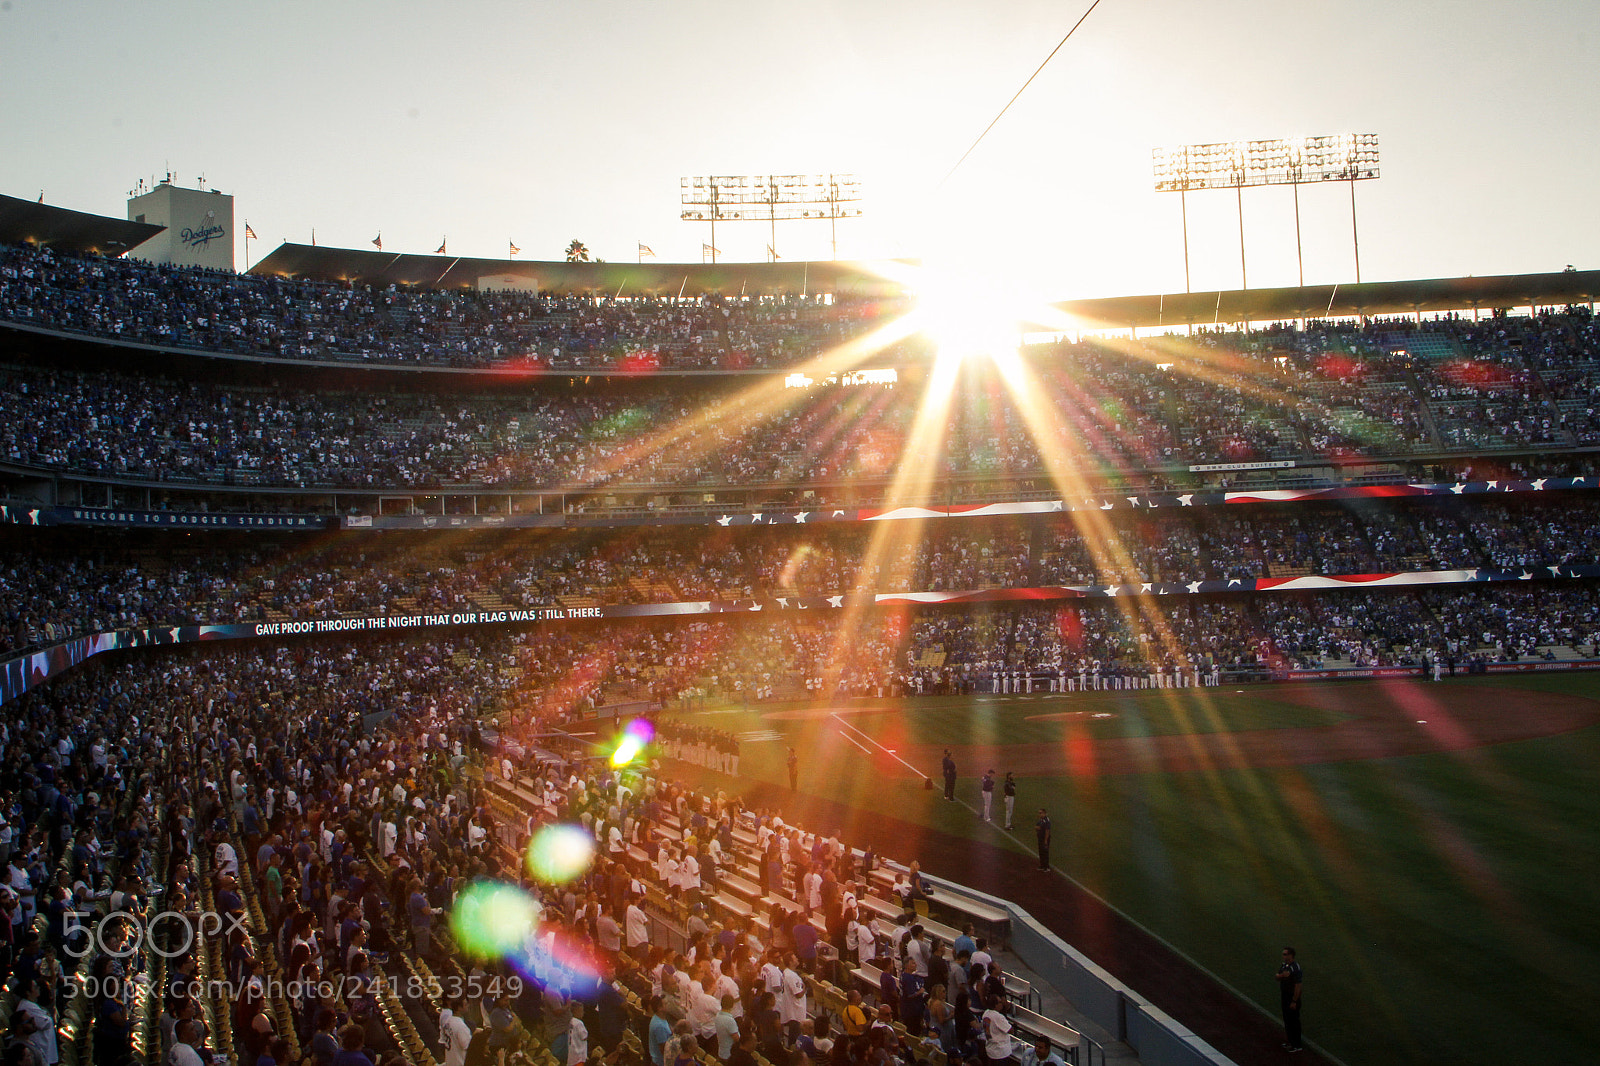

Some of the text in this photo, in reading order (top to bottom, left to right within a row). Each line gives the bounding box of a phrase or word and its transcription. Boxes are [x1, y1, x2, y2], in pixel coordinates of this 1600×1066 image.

[181, 225, 225, 246] Dodgers
[73, 510, 306, 525] WELCOME TO DODGER STADIUM
[255, 623, 280, 636] GAVE
[281, 621, 314, 634] PROOF
[316, 618, 365, 631] THROUGH
[367, 617, 386, 629] THE
[388, 615, 422, 627] NIGHT
[424, 614, 450, 626] THAT
[452, 612, 477, 624] OUR
[479, 611, 507, 623] FLAG
[510, 610, 536, 621] WAS
[567, 607, 605, 619] THERE,
